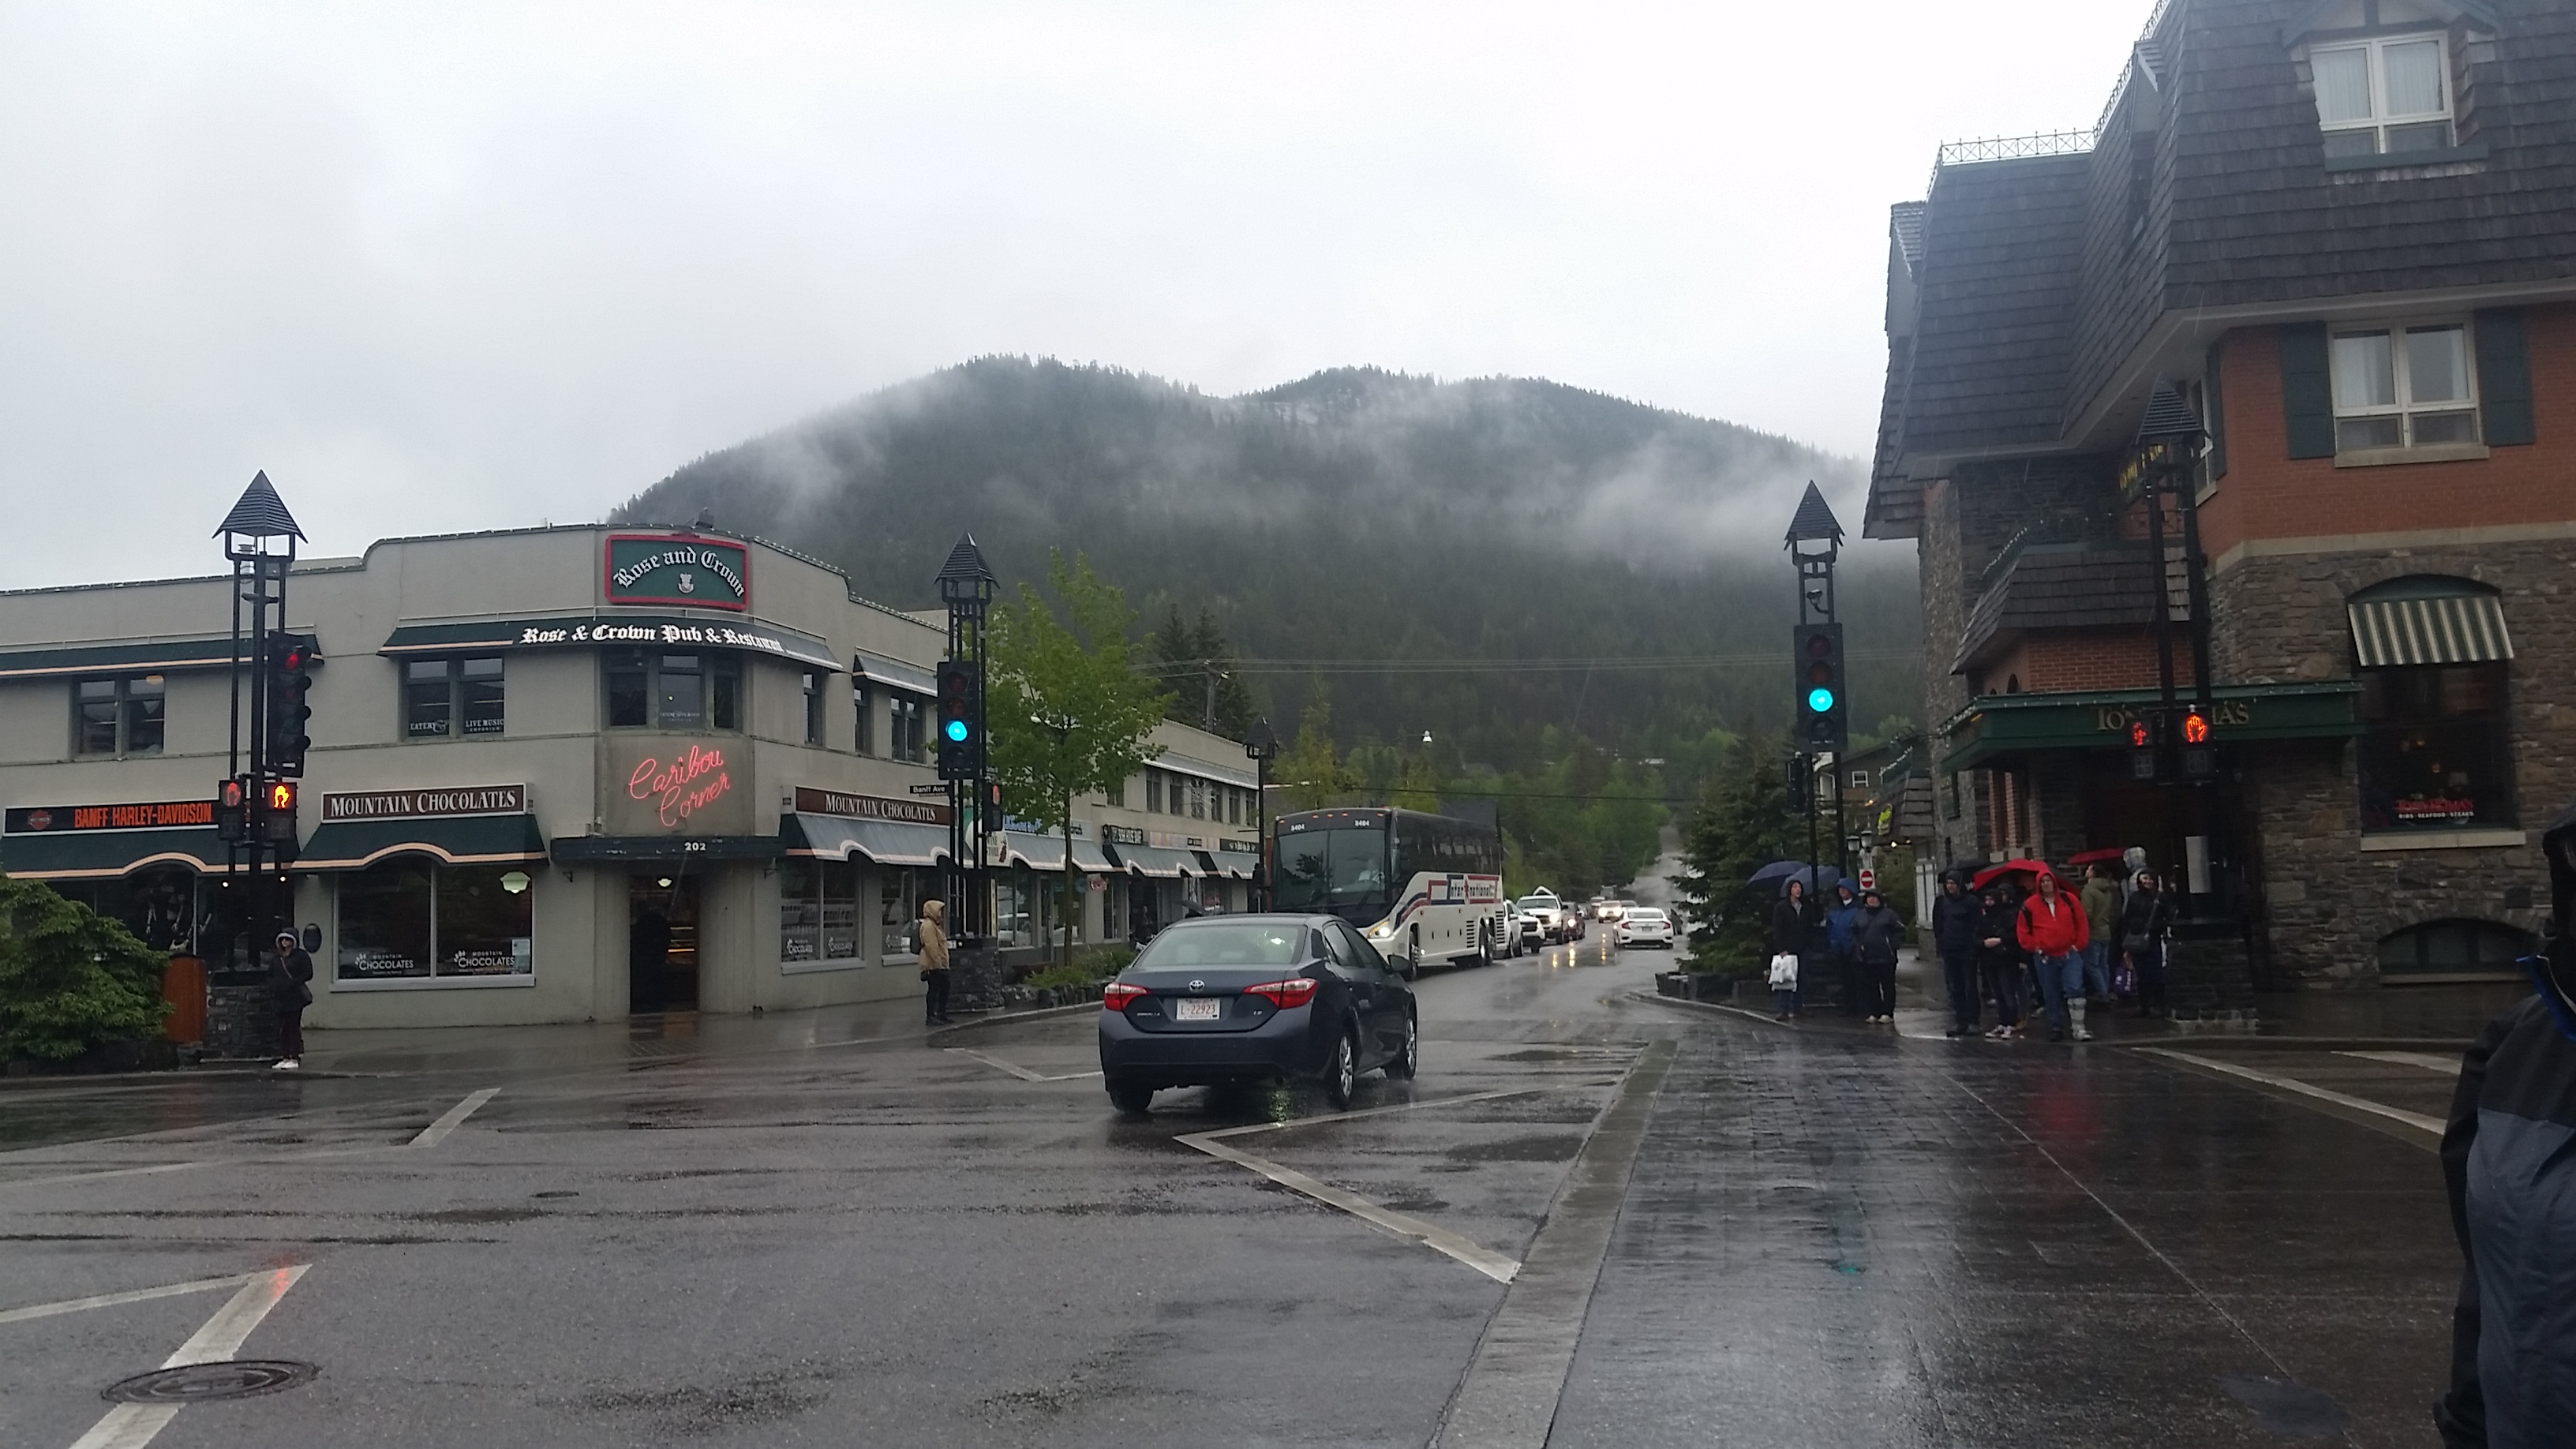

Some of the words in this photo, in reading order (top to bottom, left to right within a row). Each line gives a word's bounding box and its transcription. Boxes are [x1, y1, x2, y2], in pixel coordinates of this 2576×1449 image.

[613, 555, 661, 589] Rose
[663, 546, 696, 565] and
[701, 550, 744, 597] Crown
[519, 627, 567, 644] Rose
[571, 624, 589, 641] &
[592, 623, 657, 641] Crown
[660, 624, 702, 643] Pub
[706, 627, 722, 643] &
[722, 628, 784, 653] Restaurant
[629, 746, 724, 799] Caribou
[331, 796, 411, 817] MOUNTAIN
[416, 790, 516, 813] CHOCOLATES
[661, 773, 731, 826] Corner
[825, 794, 878, 815] MOUNTAIN
[881, 800, 936, 821] CHOCOLATES
[74, 807, 108, 828] BANFF
[112, 803, 212, 826] HARLEY-DAVIDSON
[684, 842, 706, 851] 202
[359, 960, 414, 971] CHOCOLATES
[459, 956, 515, 968] CHOCOLATES
